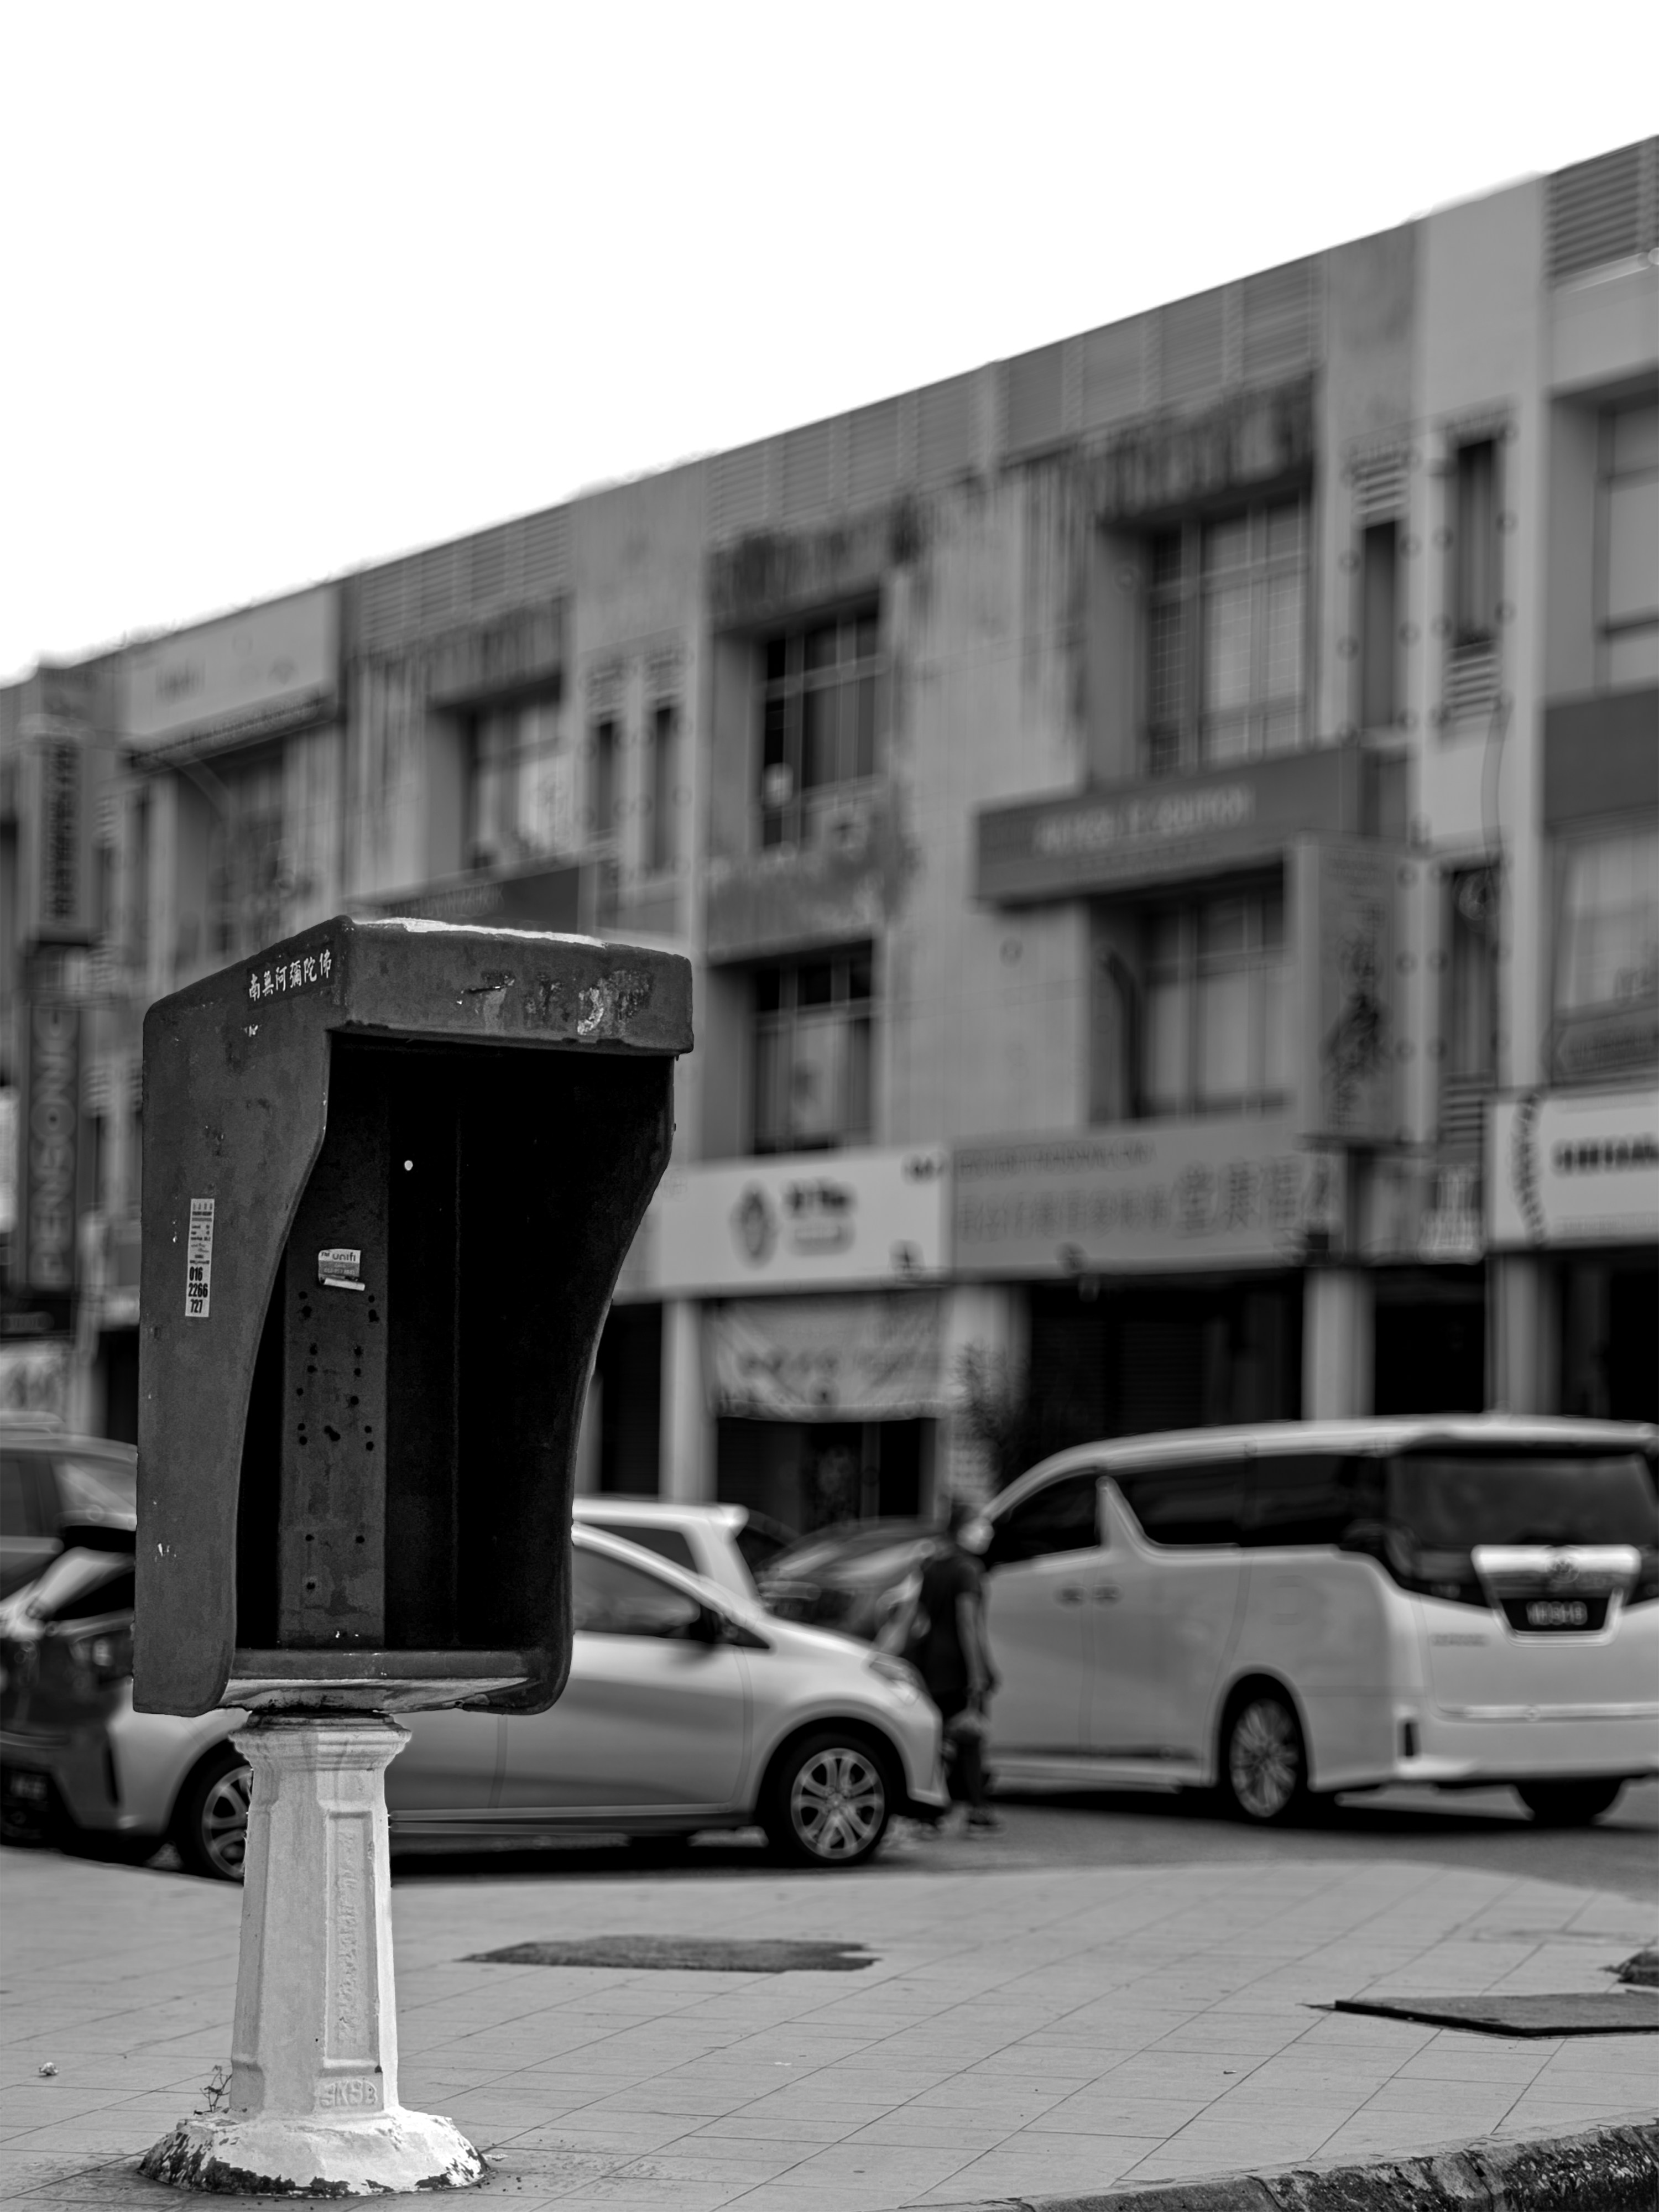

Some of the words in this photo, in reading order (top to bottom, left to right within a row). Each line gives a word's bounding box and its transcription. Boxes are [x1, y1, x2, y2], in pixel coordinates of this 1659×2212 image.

[249, 950, 332, 1001] 南無阿彌陀佛
[333, 1253, 356, 1261] unifi
[189, 1266, 203, 1281] 016
[189, 1283, 208, 1297] 2266
[190, 1299, 203, 1313] 727
